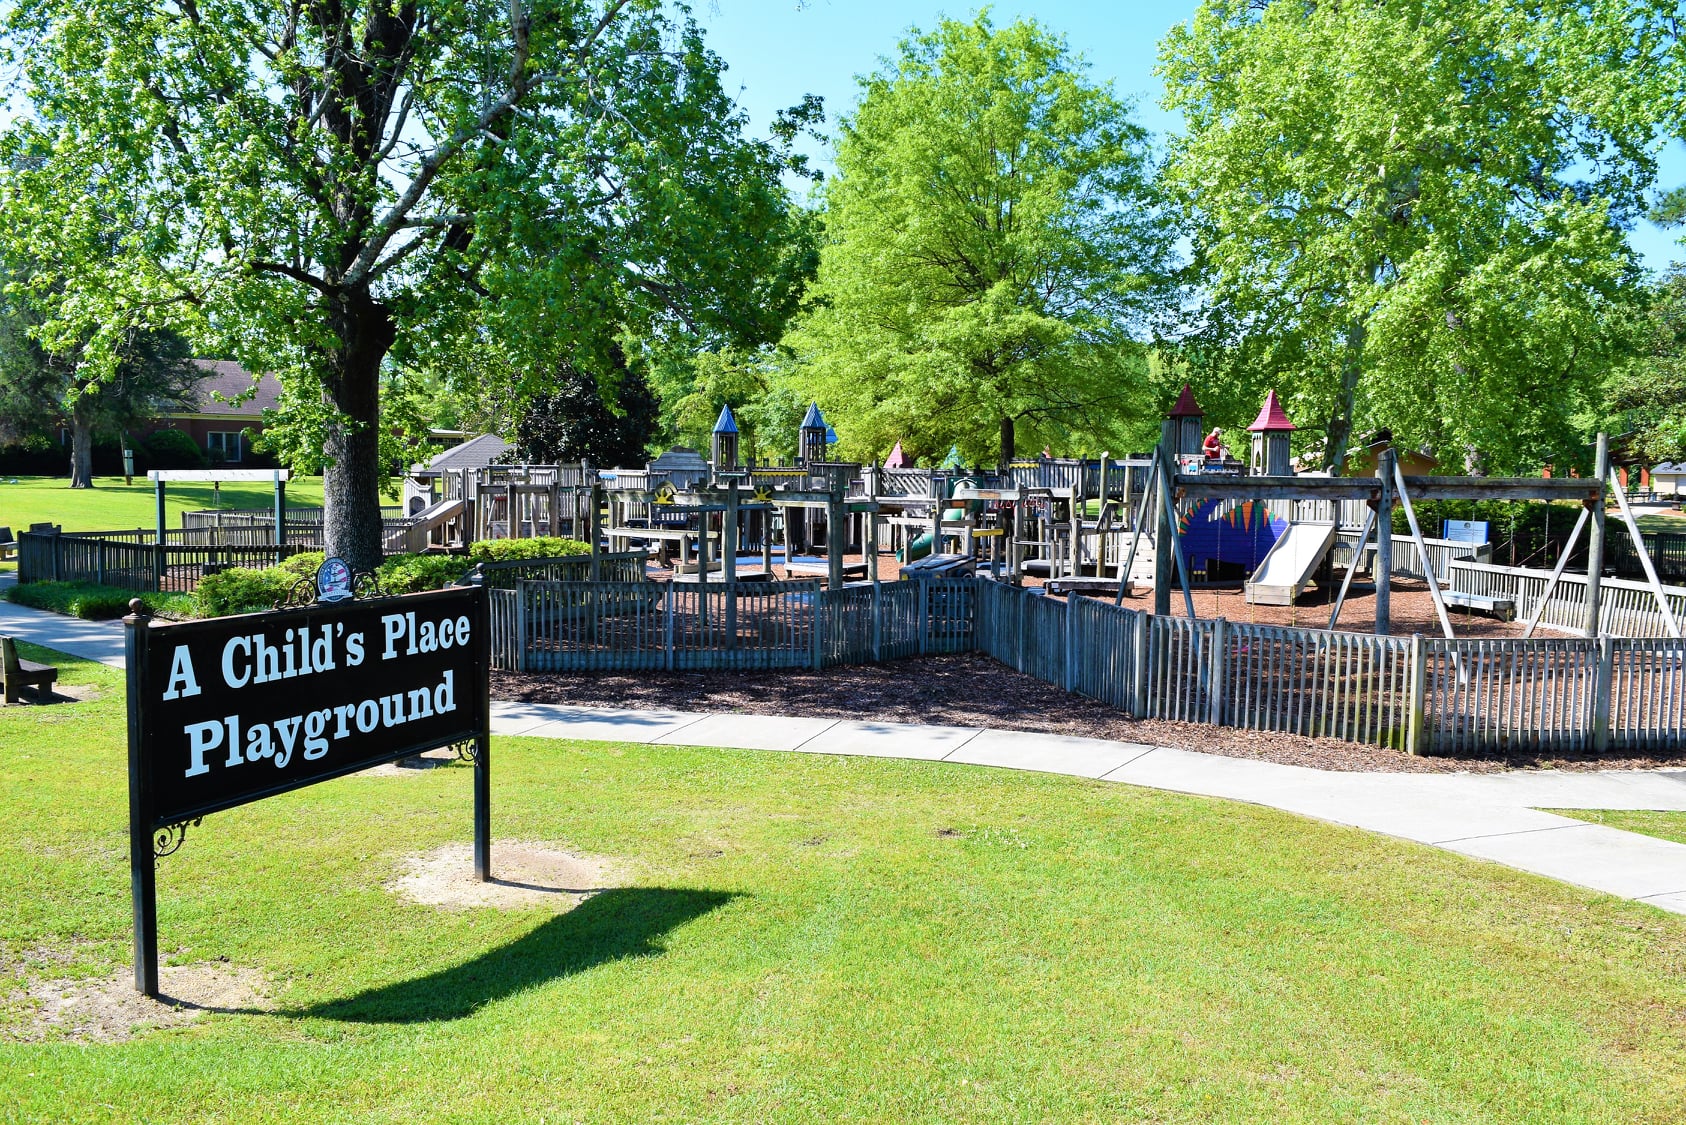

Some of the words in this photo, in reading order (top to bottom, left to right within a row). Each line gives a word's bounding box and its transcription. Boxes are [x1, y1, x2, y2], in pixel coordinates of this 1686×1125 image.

[162, 645, 201, 701] A
[222, 622, 365, 689] Child's
[381, 611, 471, 661] Place
[184, 670, 457, 778] Playground
